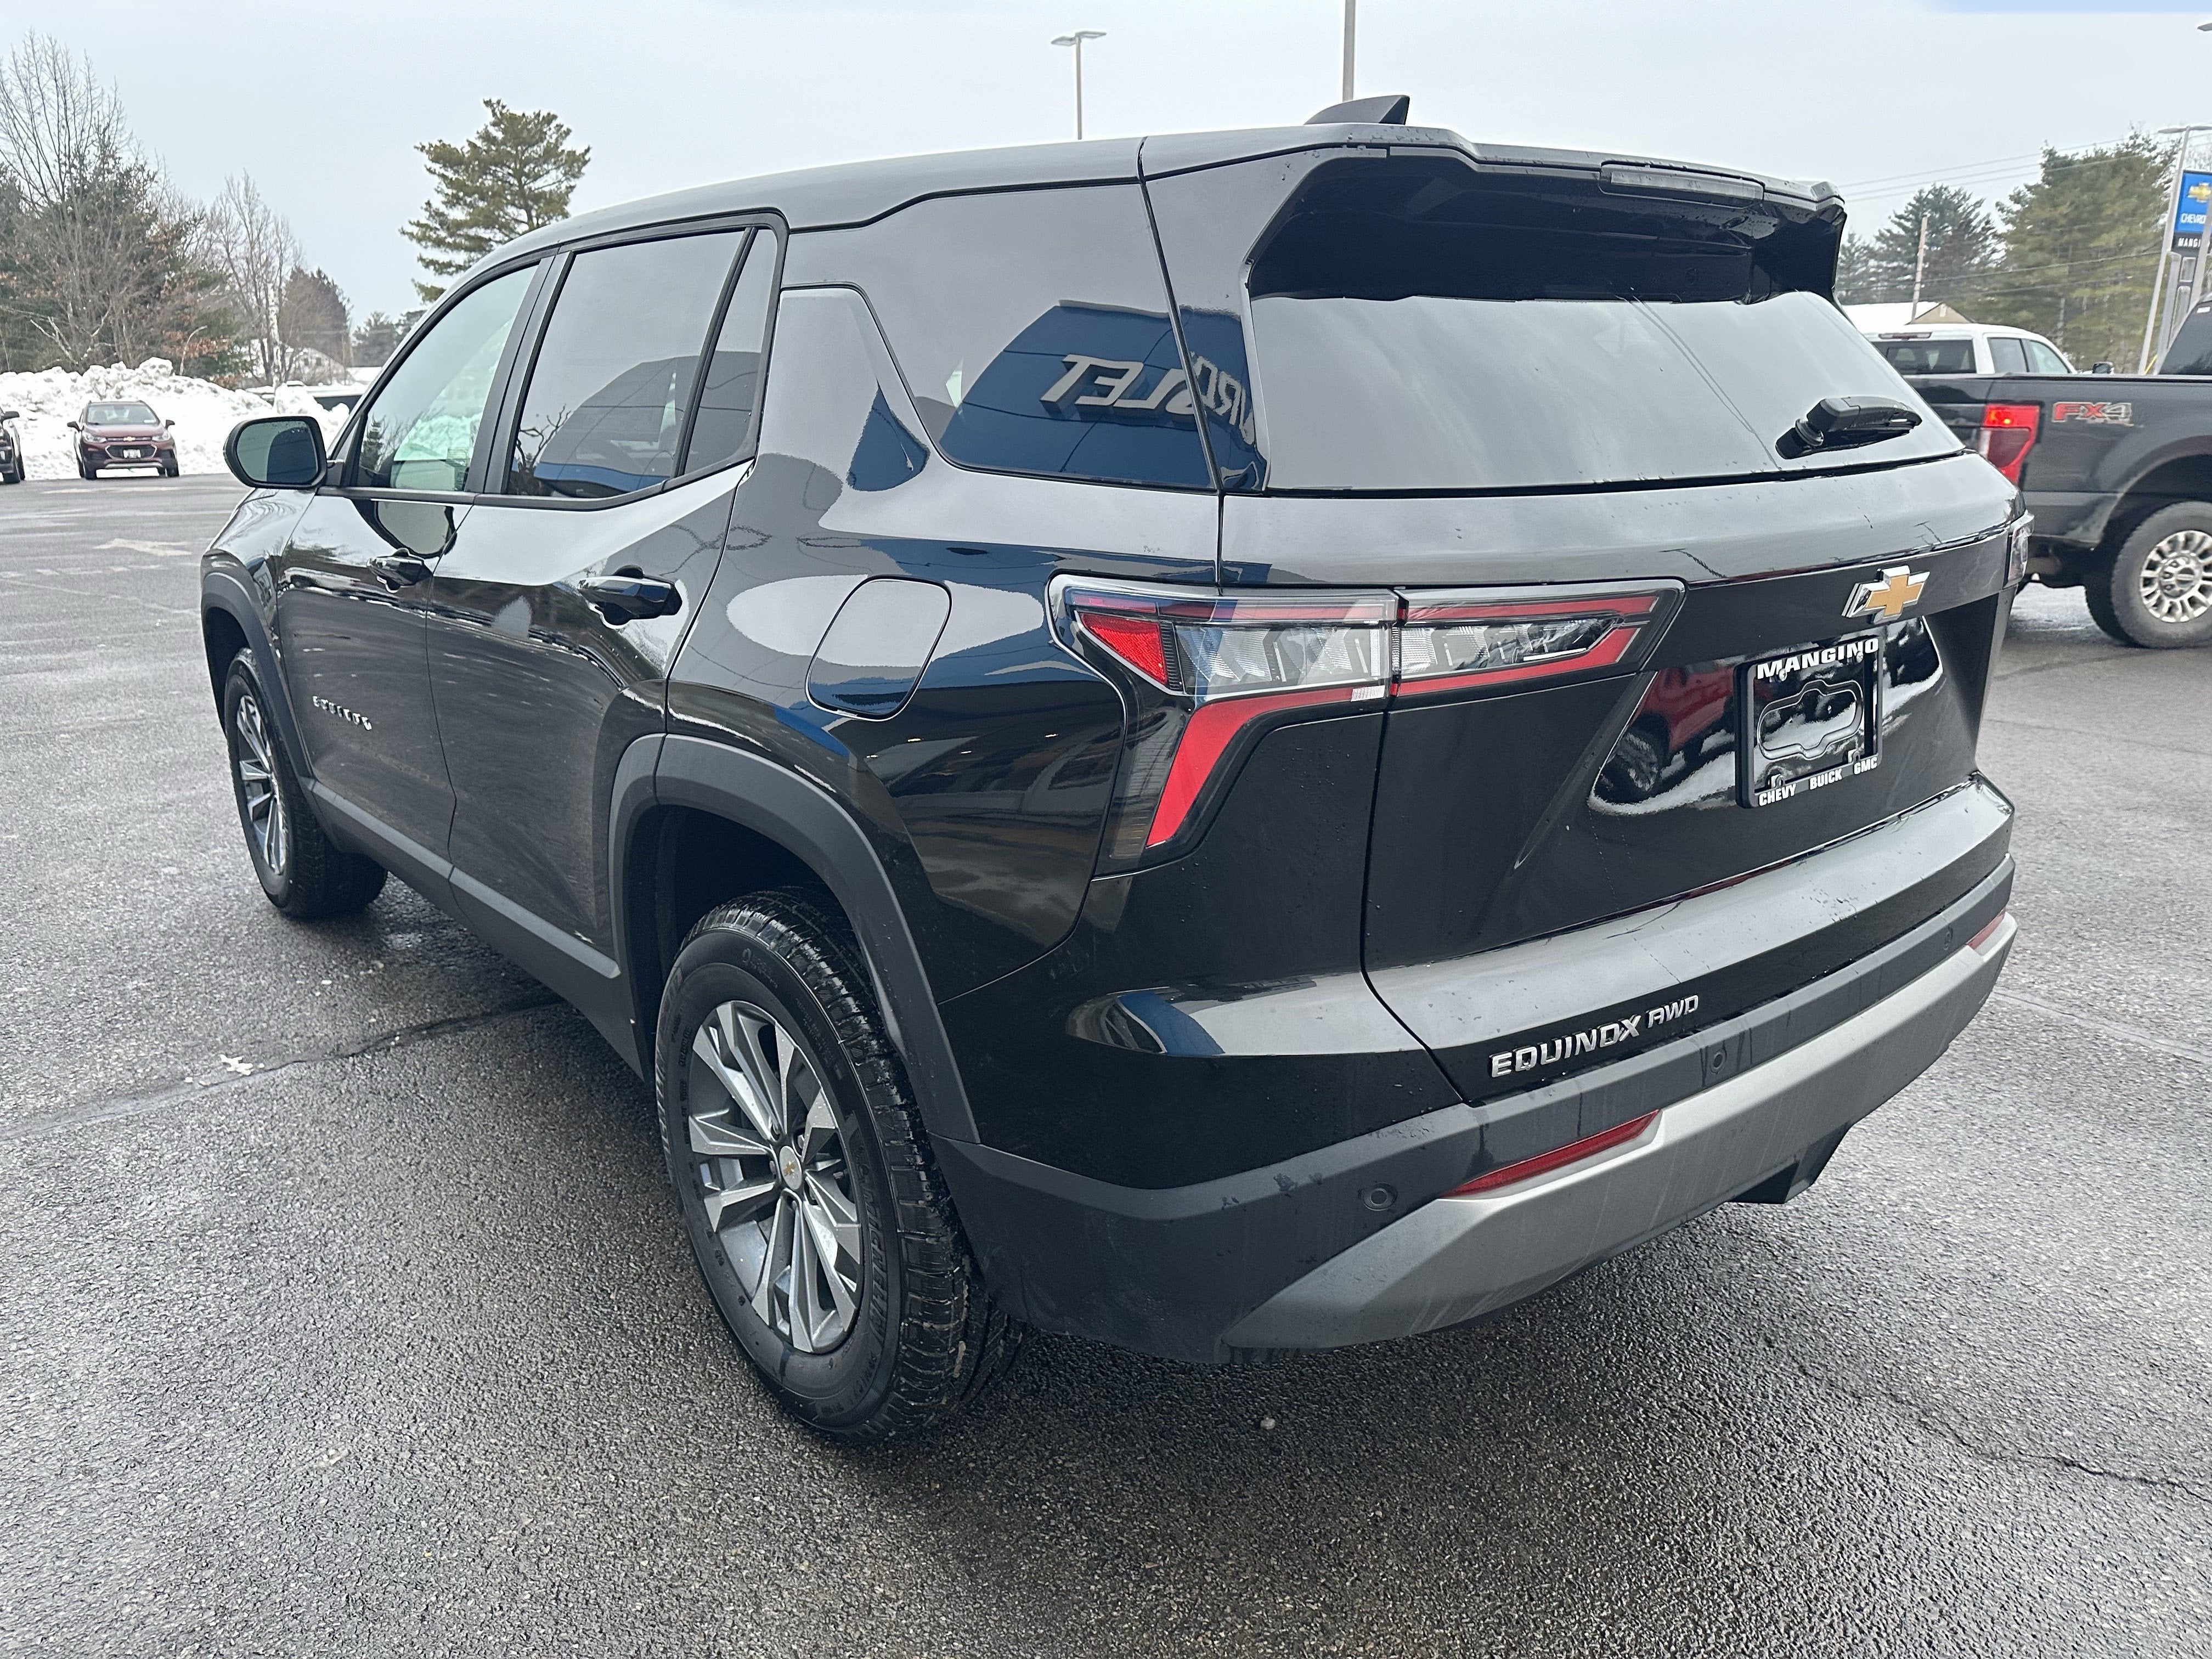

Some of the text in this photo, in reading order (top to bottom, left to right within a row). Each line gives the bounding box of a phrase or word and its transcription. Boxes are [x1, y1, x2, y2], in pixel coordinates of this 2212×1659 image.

[2051, 401, 2132, 423] FX4
[1757, 637, 1879, 680] MANGINO
[1759, 757, 1878, 806] CHEVY BUICK GMC
[1489, 995, 1699, 1077] EQUINOX AWD
